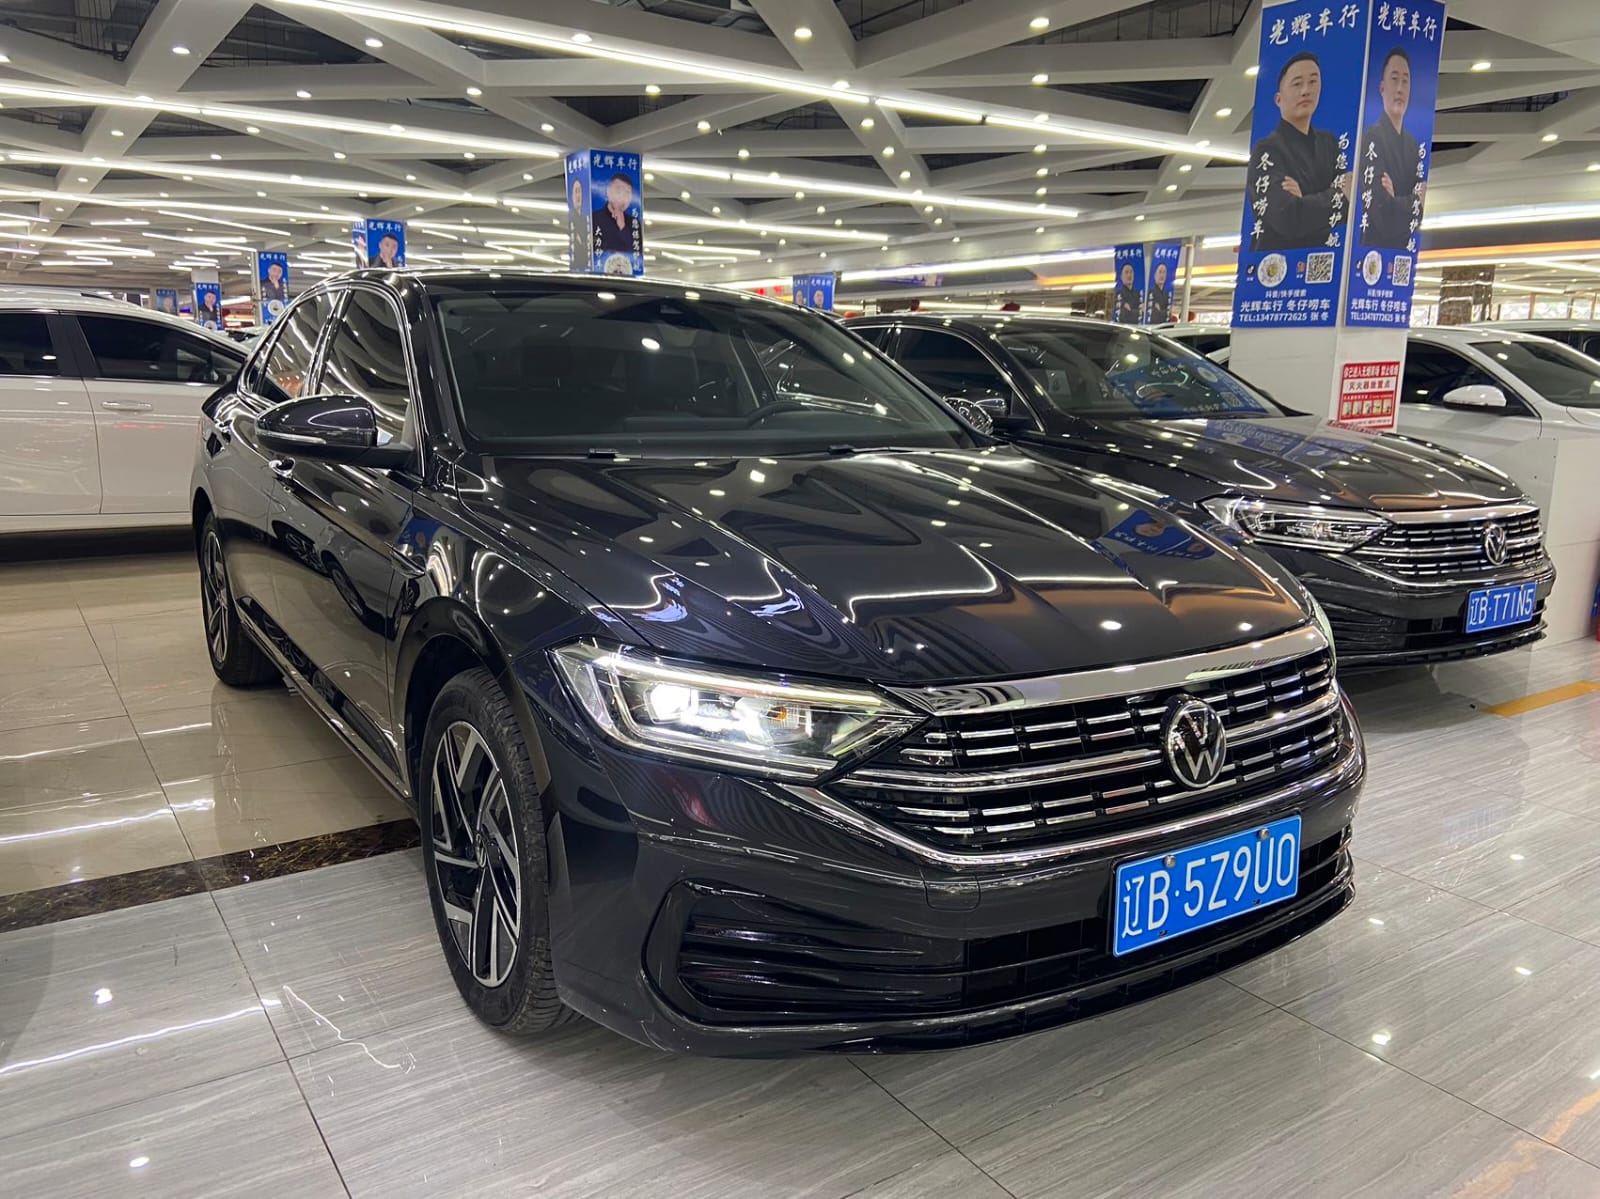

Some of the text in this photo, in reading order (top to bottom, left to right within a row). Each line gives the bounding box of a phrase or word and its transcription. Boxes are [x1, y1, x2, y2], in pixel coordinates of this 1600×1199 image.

[1269, 4, 1360, 45] 光辉车行
[1377, 2, 1437, 42] 光辉车行
[593, 154, 638, 170] 光辉车行
[1325, 132, 1350, 247] 为您保驾护航
[1240, 300, 1283, 312] 光辉车行
[1121, 832, 1296, 938] 辽B·5Z9U0
